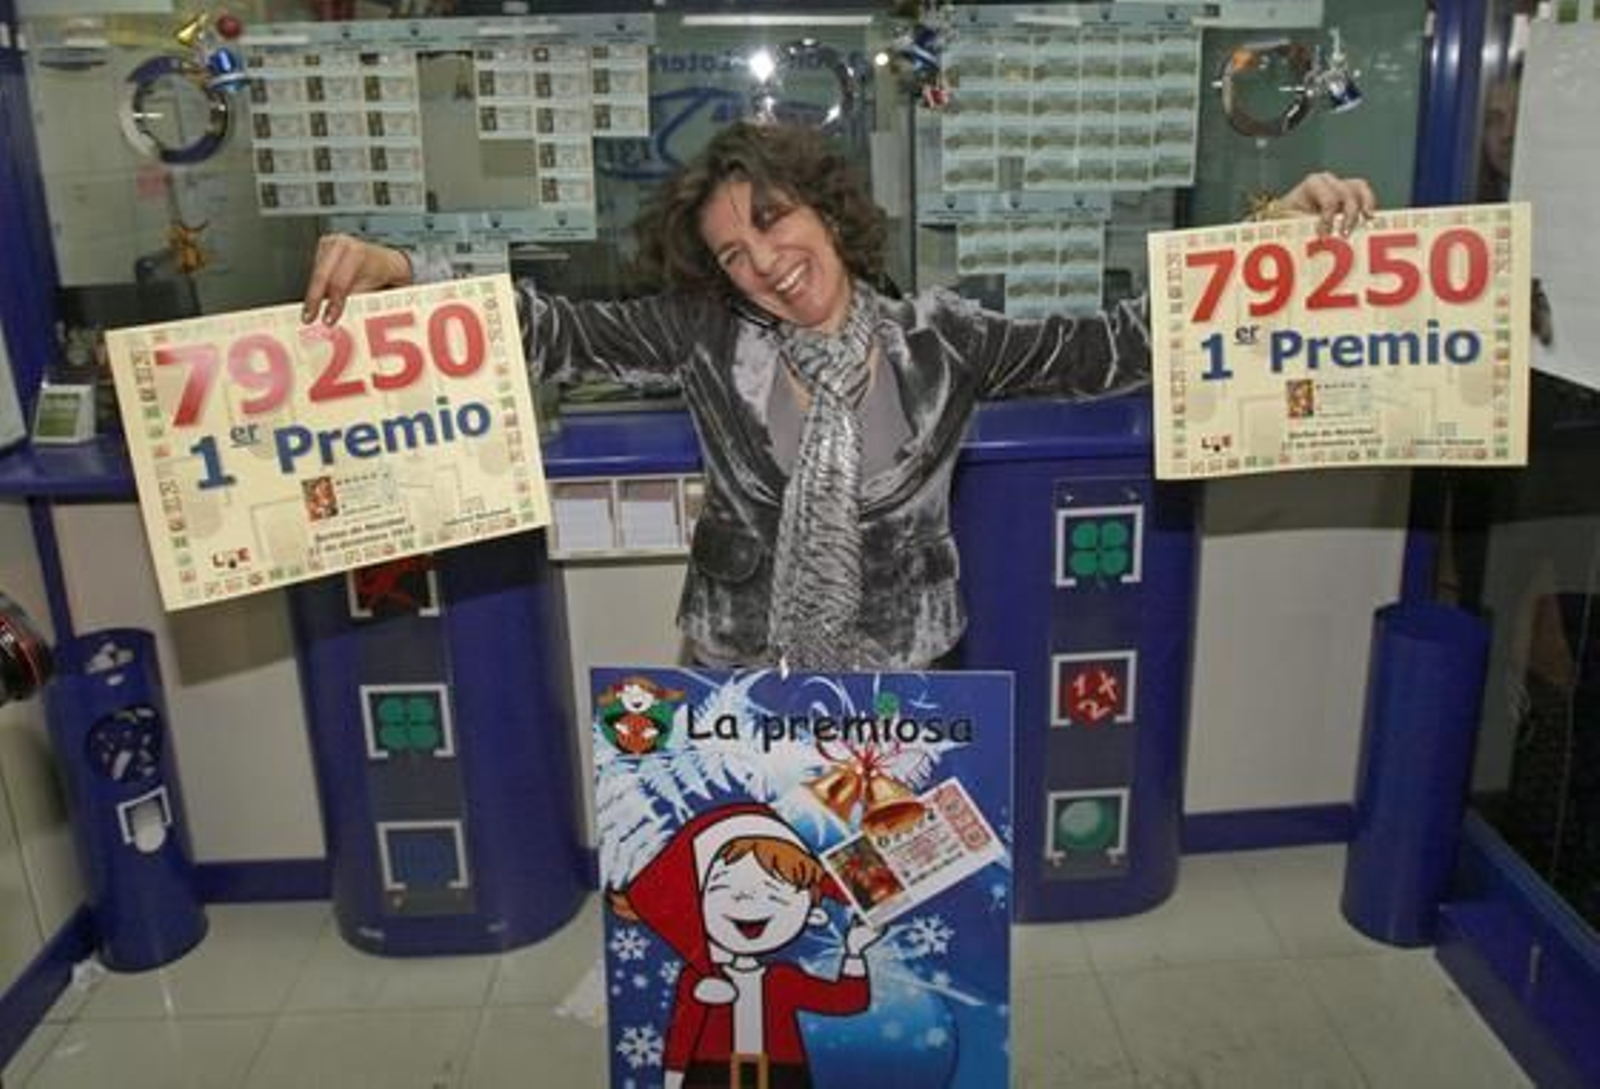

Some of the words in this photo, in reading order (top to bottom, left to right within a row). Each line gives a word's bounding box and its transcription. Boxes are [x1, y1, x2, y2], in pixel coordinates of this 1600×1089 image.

[1185, 227, 1489, 324] 79250
[154, 303, 486, 428] 79250
[1270, 320, 1481, 373] Premio
[273, 396, 491, 474] Premio
[686, 708, 739, 740] La
[761, 708, 973, 752] premiosa
